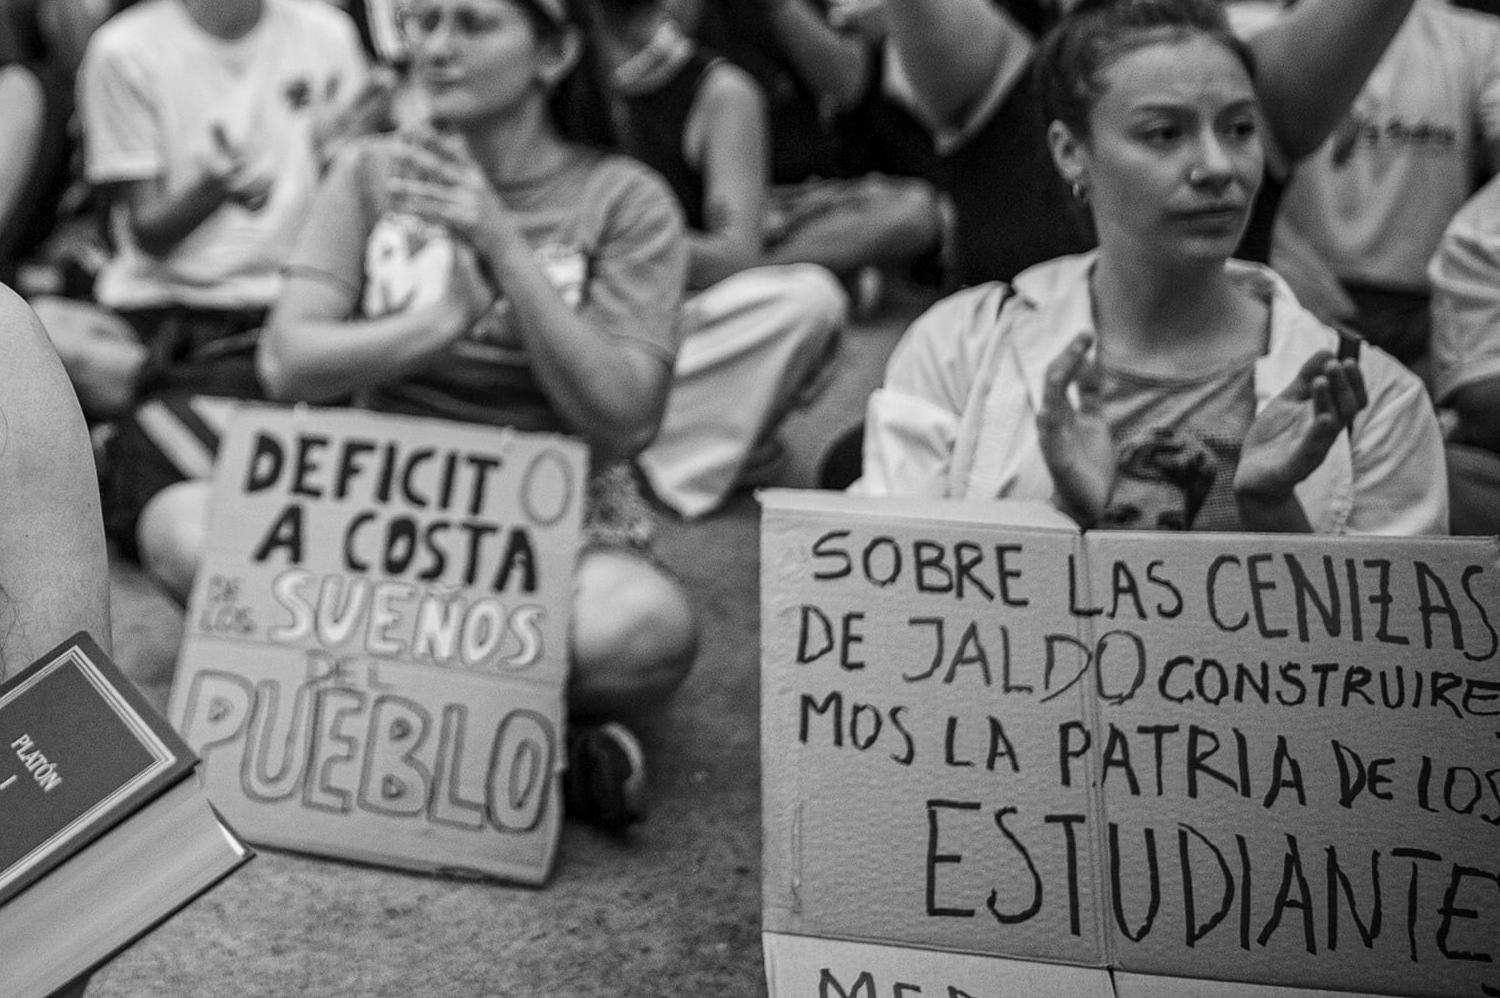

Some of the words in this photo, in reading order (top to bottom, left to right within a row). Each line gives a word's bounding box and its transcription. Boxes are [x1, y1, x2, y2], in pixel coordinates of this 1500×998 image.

[243, 430, 502, 518] DEFICIT
[252, 502, 307, 566] A
[342, 510, 538, 596] COSTA
[812, 529, 1030, 607] SOBRE
[1068, 554, 1184, 620] LAS
[1206, 552, 1498, 662] CENIZAS
[268, 566, 550, 674] SUEÑOS
[300, 647, 397, 692] DEL
[796, 604, 866, 672] DE
[902, 616, 1148, 705] JALDO
[11, 733, 62, 793] PLATÓN
[180, 667, 558, 836] PUEBLO
[797, 690, 916, 768] MOS
[943, 714, 1022, 774] LA
[1057, 720, 1308, 810] PATRIA
[1330, 738, 1398, 810] DE
[1416, 754, 1500, 827] LOS
[925, 799, 1500, 970] ESTUDIANTE
